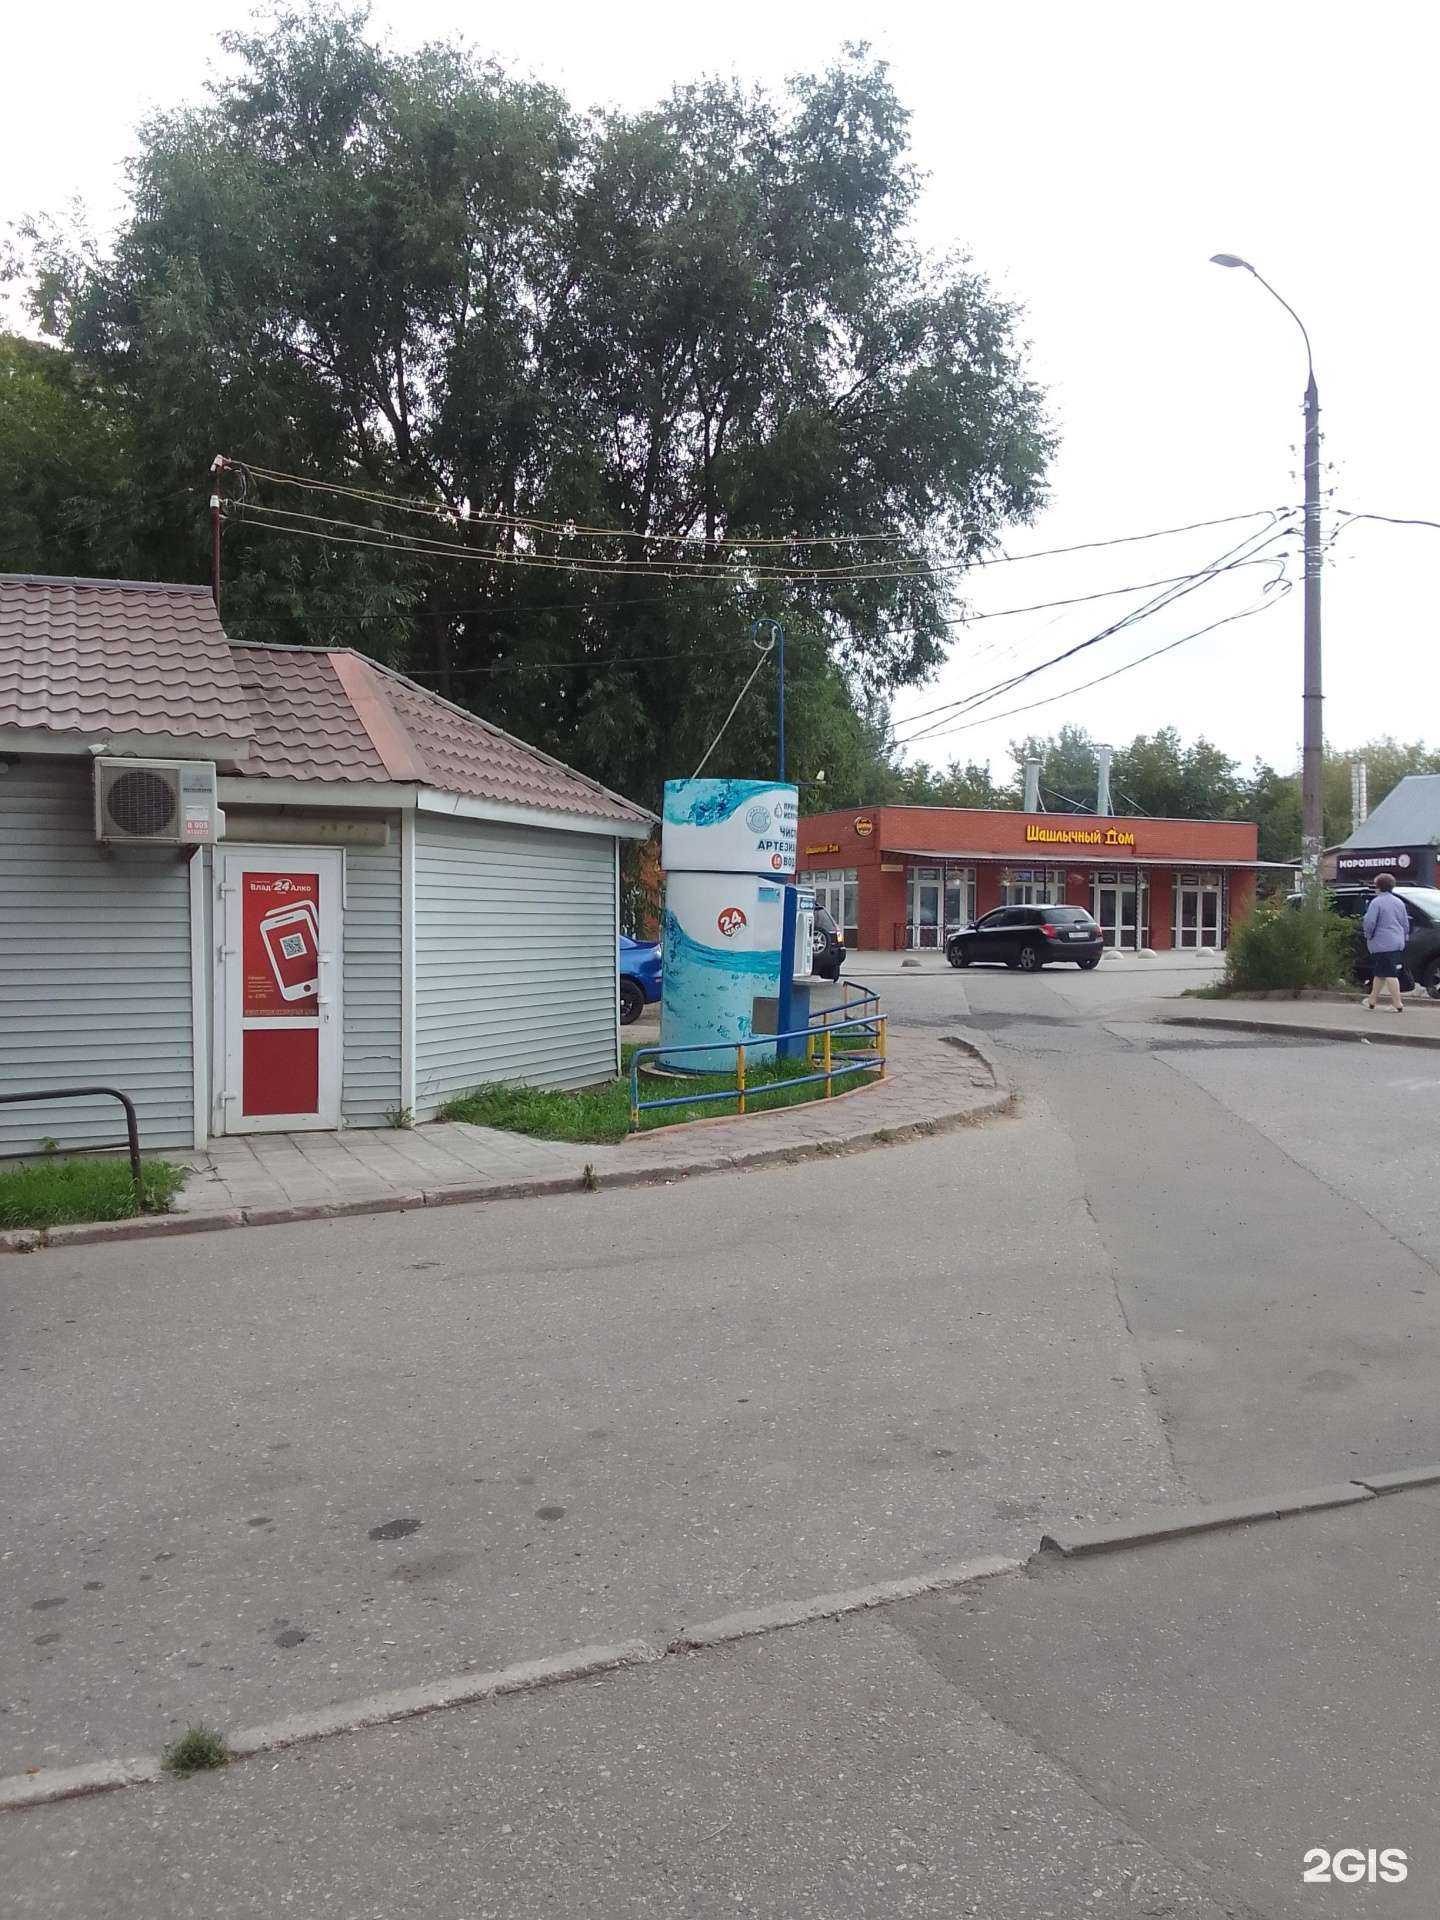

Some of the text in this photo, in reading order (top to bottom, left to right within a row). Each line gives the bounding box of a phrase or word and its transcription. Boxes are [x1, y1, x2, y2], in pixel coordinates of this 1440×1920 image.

[1026, 825, 1134, 845] Шашлычный Дом
[1340, 857, 1397, 869] МОРОЖЕНОЕ
[250, 881, 311, 892] Влад 24 Алко
[720, 910, 742, 931] 24
